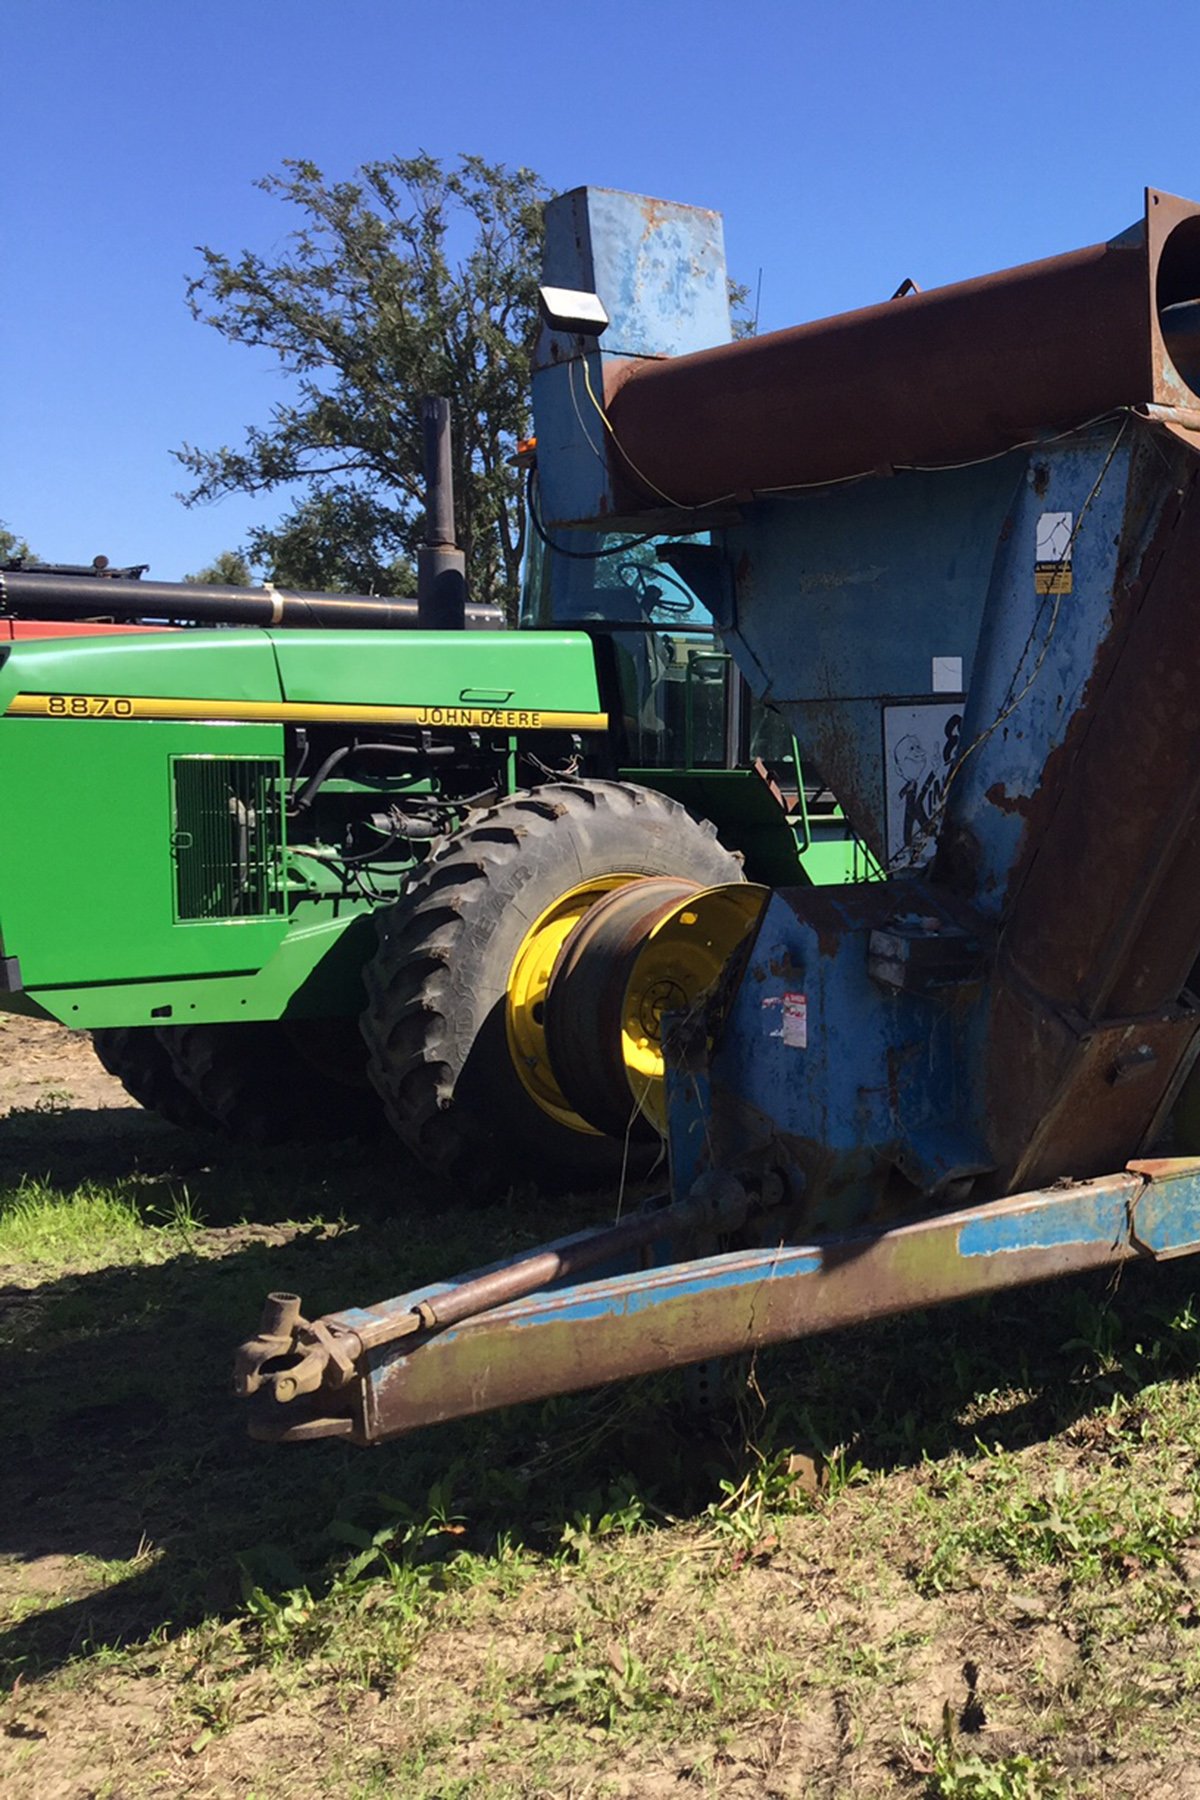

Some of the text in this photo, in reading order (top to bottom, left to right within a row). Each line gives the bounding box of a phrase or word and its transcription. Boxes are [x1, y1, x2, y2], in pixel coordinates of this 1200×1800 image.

[48, 697, 132, 715] 8870
[418, 707, 541, 727] JOHN DEERE
